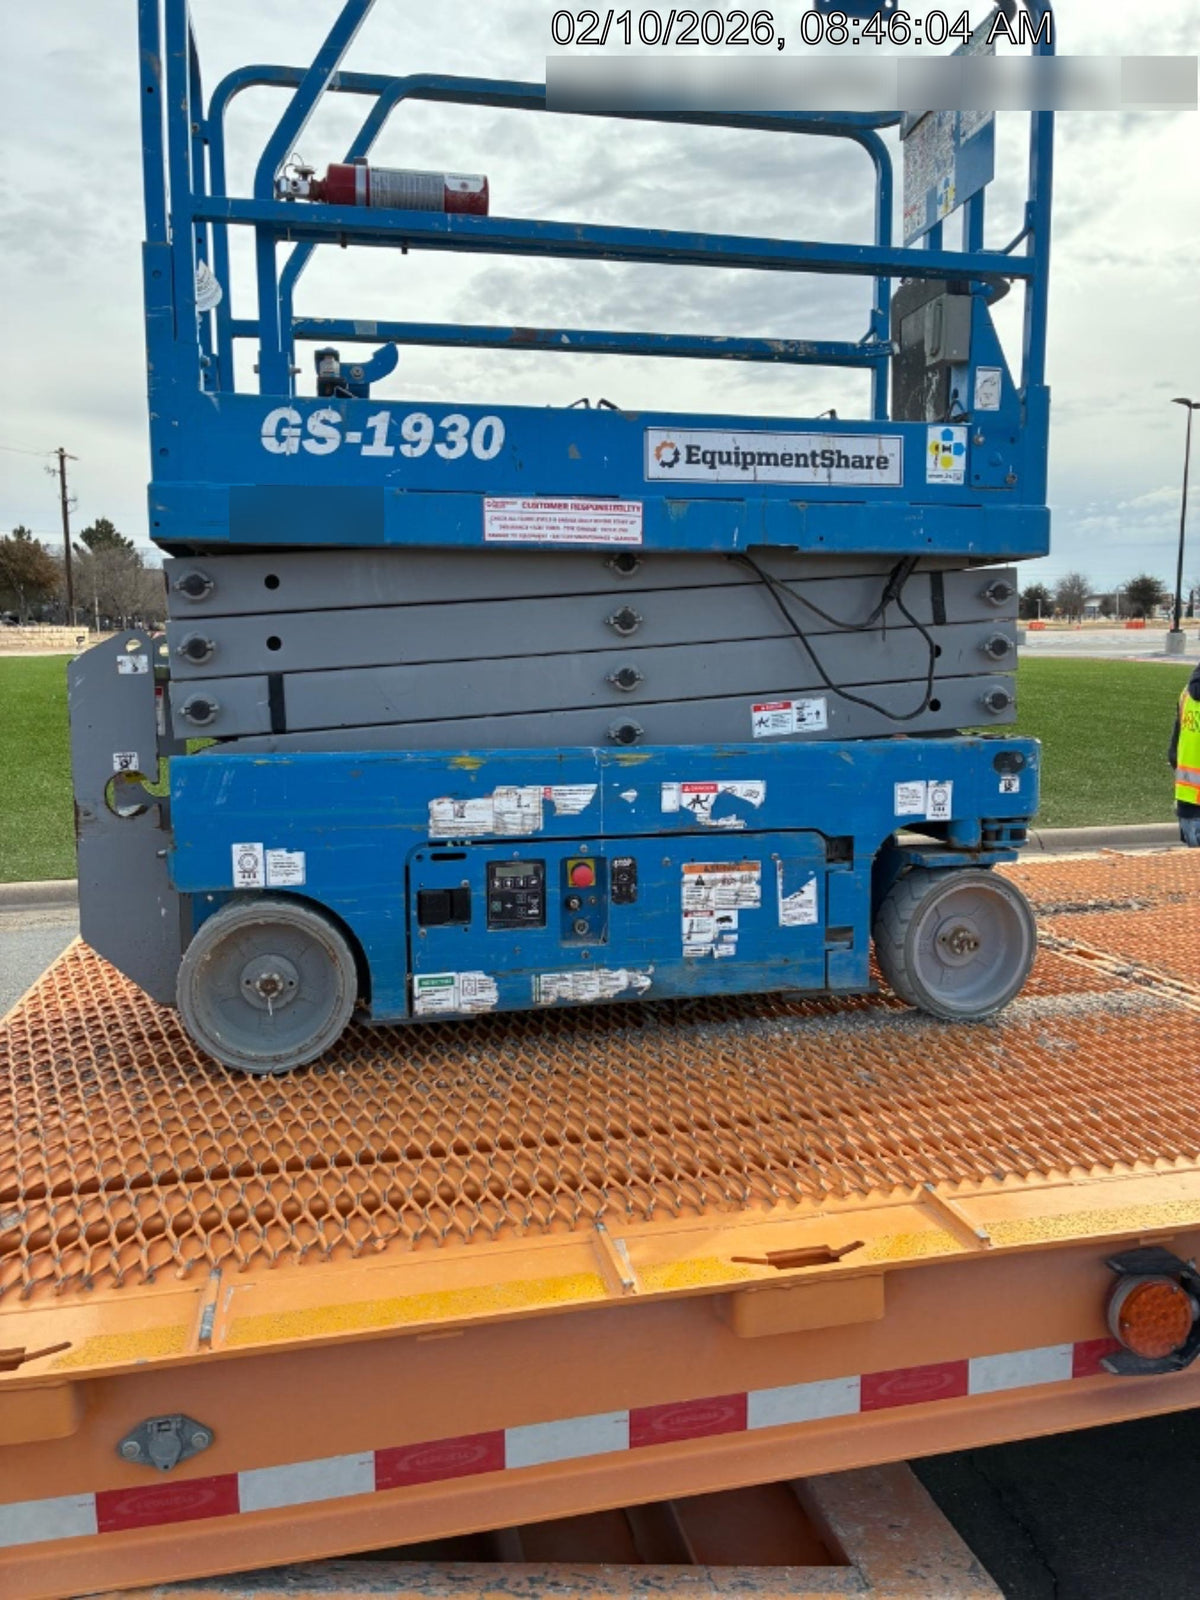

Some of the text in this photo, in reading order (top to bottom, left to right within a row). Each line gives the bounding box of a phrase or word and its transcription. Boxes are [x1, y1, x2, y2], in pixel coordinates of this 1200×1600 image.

[260, 406, 506, 461] GS-1930
[684, 444, 890, 470] EquipmentShare
[522, 501, 569, 510] CUSTOMER
